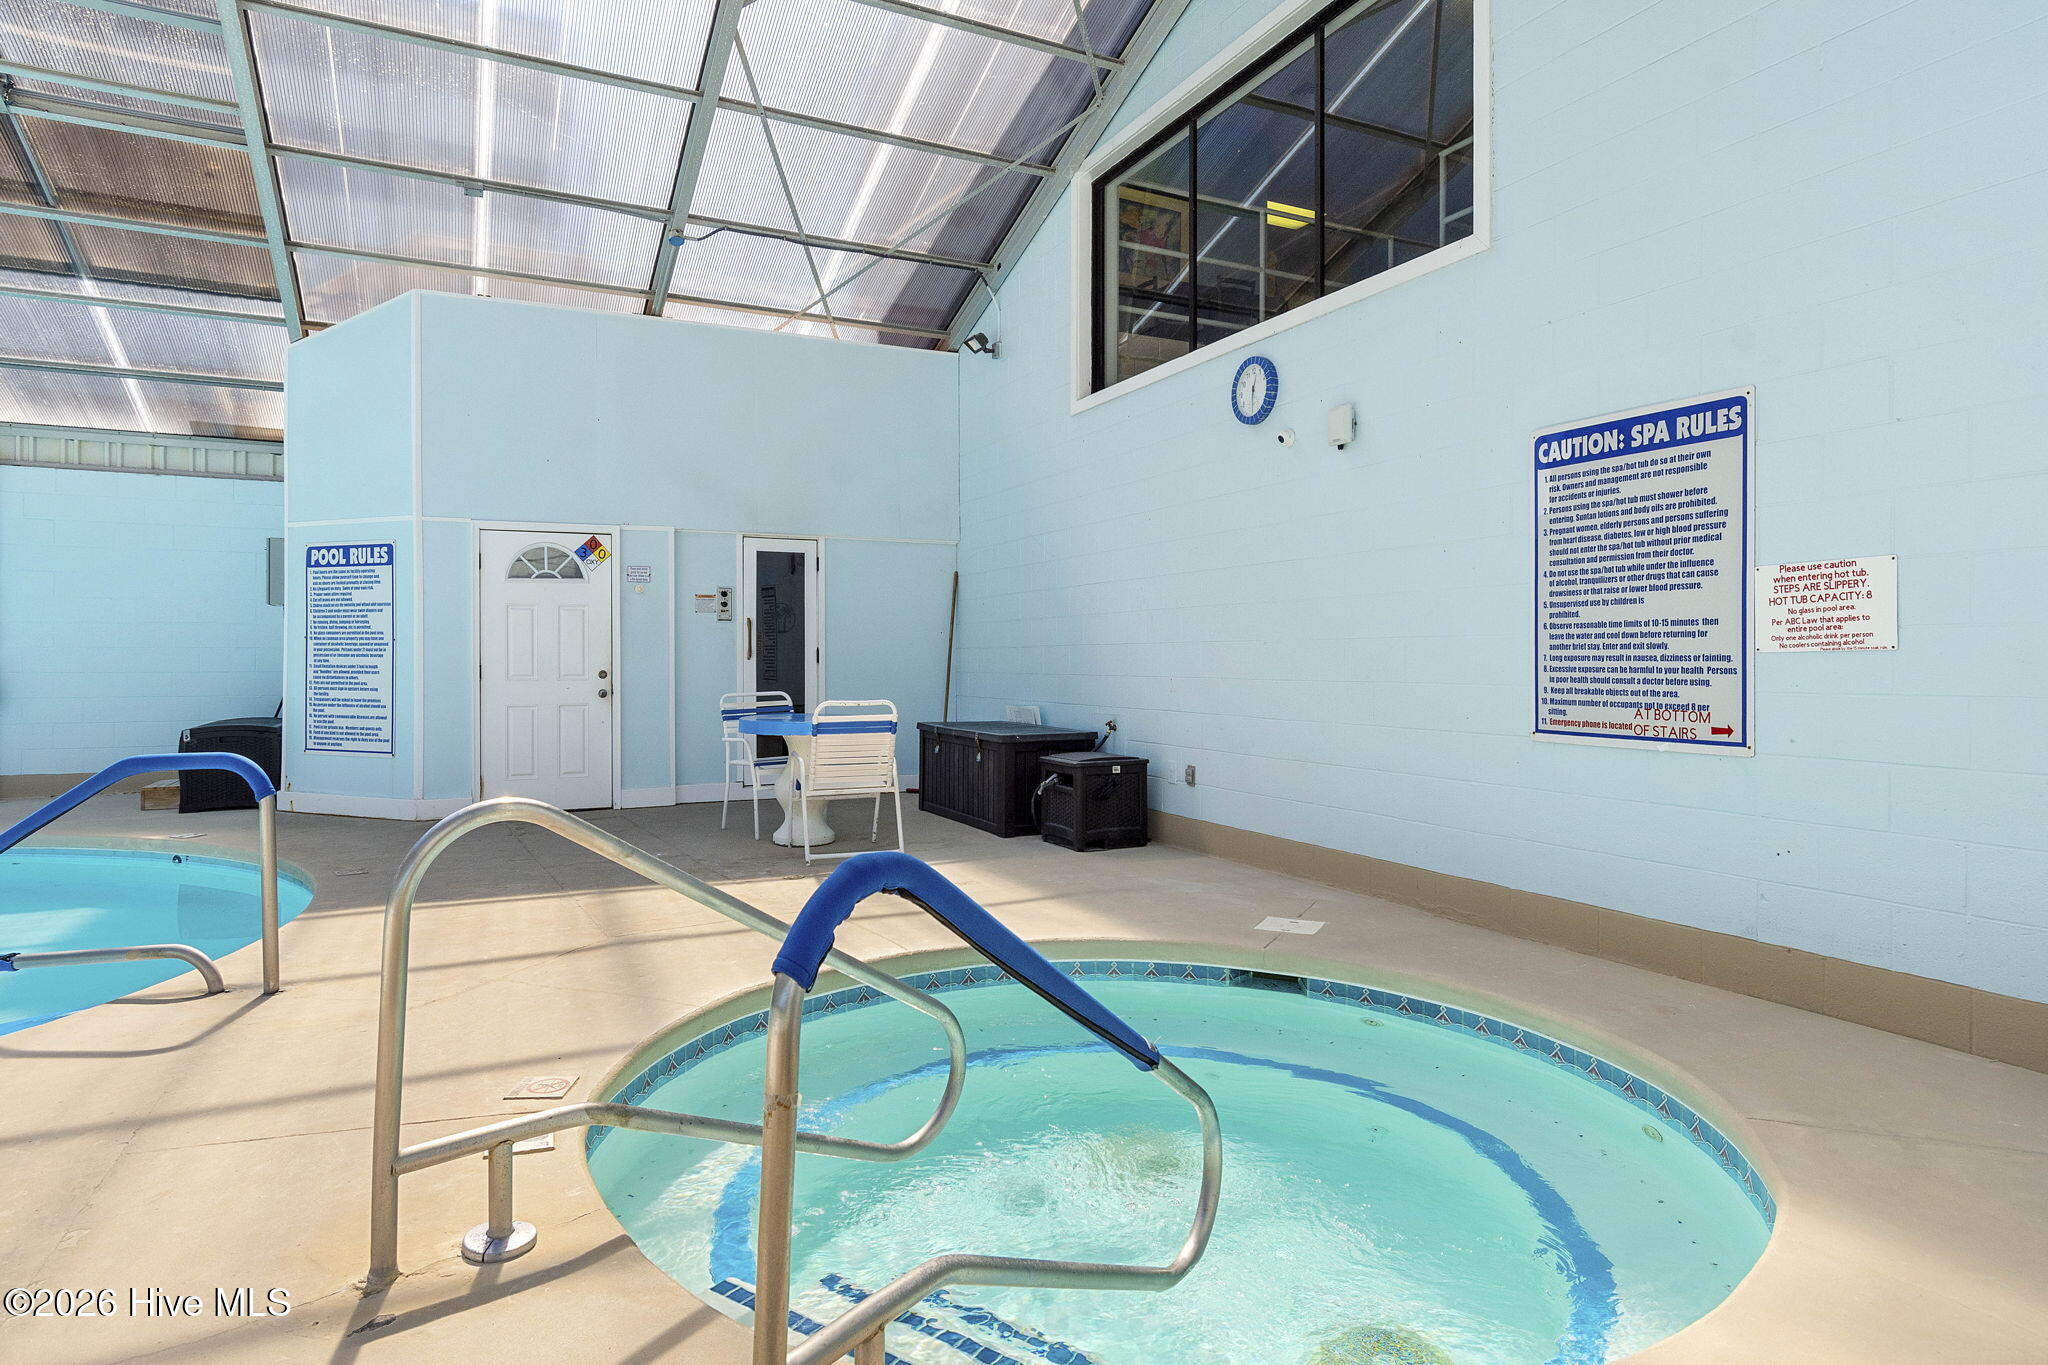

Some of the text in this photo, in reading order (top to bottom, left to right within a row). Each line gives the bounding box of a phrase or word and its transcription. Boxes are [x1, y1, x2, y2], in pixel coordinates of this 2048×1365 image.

[1538, 406, 1742, 464] CAUTION: SPA RULES
[1557, 471, 1581, 482] persons
[1582, 467, 1599, 478] using
[1600, 465, 1610, 474] the
[1637, 459, 1648, 468] tub
[1649, 457, 1658, 466] do
[1669, 454, 1676, 463] at
[1677, 451, 1694, 462] their
[1695, 450, 1711, 459] own
[1584, 461, 1708, 487] and management are not responsible
[1590, 485, 1708, 509] the tub must shower before
[1620, 502, 1676, 516] and oils are
[1623, 507, 1728, 528] persons and persons suffering
[1655, 525, 1670, 536] high
[1671, 523, 1692, 533] blood
[1692, 520, 1726, 532] pressure
[590, 540, 597, 549] 0
[1569, 532, 1722, 554] not enter the tub without prior medical
[311, 547, 388, 565] POOL RULES
[580, 547, 586, 558] 3
[599, 549, 606, 559] 0
[1635, 548, 1668, 559] from their
[1579, 567, 1589, 575] the
[1615, 564, 1625, 572] tub
[1626, 562, 1644, 572] while
[1645, 560, 1666, 570] under
[1667, 559, 1678, 569] the
[1679, 557, 1714, 568] influence
[1779, 563, 1805, 572] Please
[1824, 559, 1856, 569] caution
[1626, 573, 1644, 582] other
[1645, 571, 1665, 582] drugs
[1666, 570, 1680, 579] that
[1696, 569, 1718, 577] cause
[1772, 567, 1868, 583] when entering hot tub.
[1590, 586, 1602, 595] that
[1603, 585, 1619, 594] raise
[1628, 583, 1647, 592] lower
[1648, 582, 1668, 591] blood
[1773, 578, 1869, 593] STEPS ARE SLIPPERY.
[1601, 597, 1609, 606] by
[1638, 596, 1644, 604] is
[1768, 596, 1787, 605] HOT
[1791, 594, 1807, 604] TUB
[1866, 590, 1872, 598] 8
[1798, 606, 1814, 615] glass
[1643, 616, 1719, 627] of 10-15 minutes then
[1835, 614, 1860, 623] applies
[1621, 630, 1638, 638] down
[1639, 630, 1661, 638] before
[1662, 629, 1696, 638] returning
[1697, 629, 1708, 637] for
[1808, 624, 1824, 632] pool
[1602, 641, 1644, 650] Enter and exit
[1655, 665, 1663, 673] to
[1706, 665, 1738, 674] Persons
[1642, 677, 1664, 685] doctor
[1665, 677, 1688, 685] before
[1605, 688, 1629, 697] objects
[1649, 688, 1660, 697] the
[1691, 702, 1696, 710] 8
[1634, 708, 1711, 723] AT BOTTOM
[1601, 720, 1607, 728] is
[1634, 724, 1697, 740] OF STAIRS
